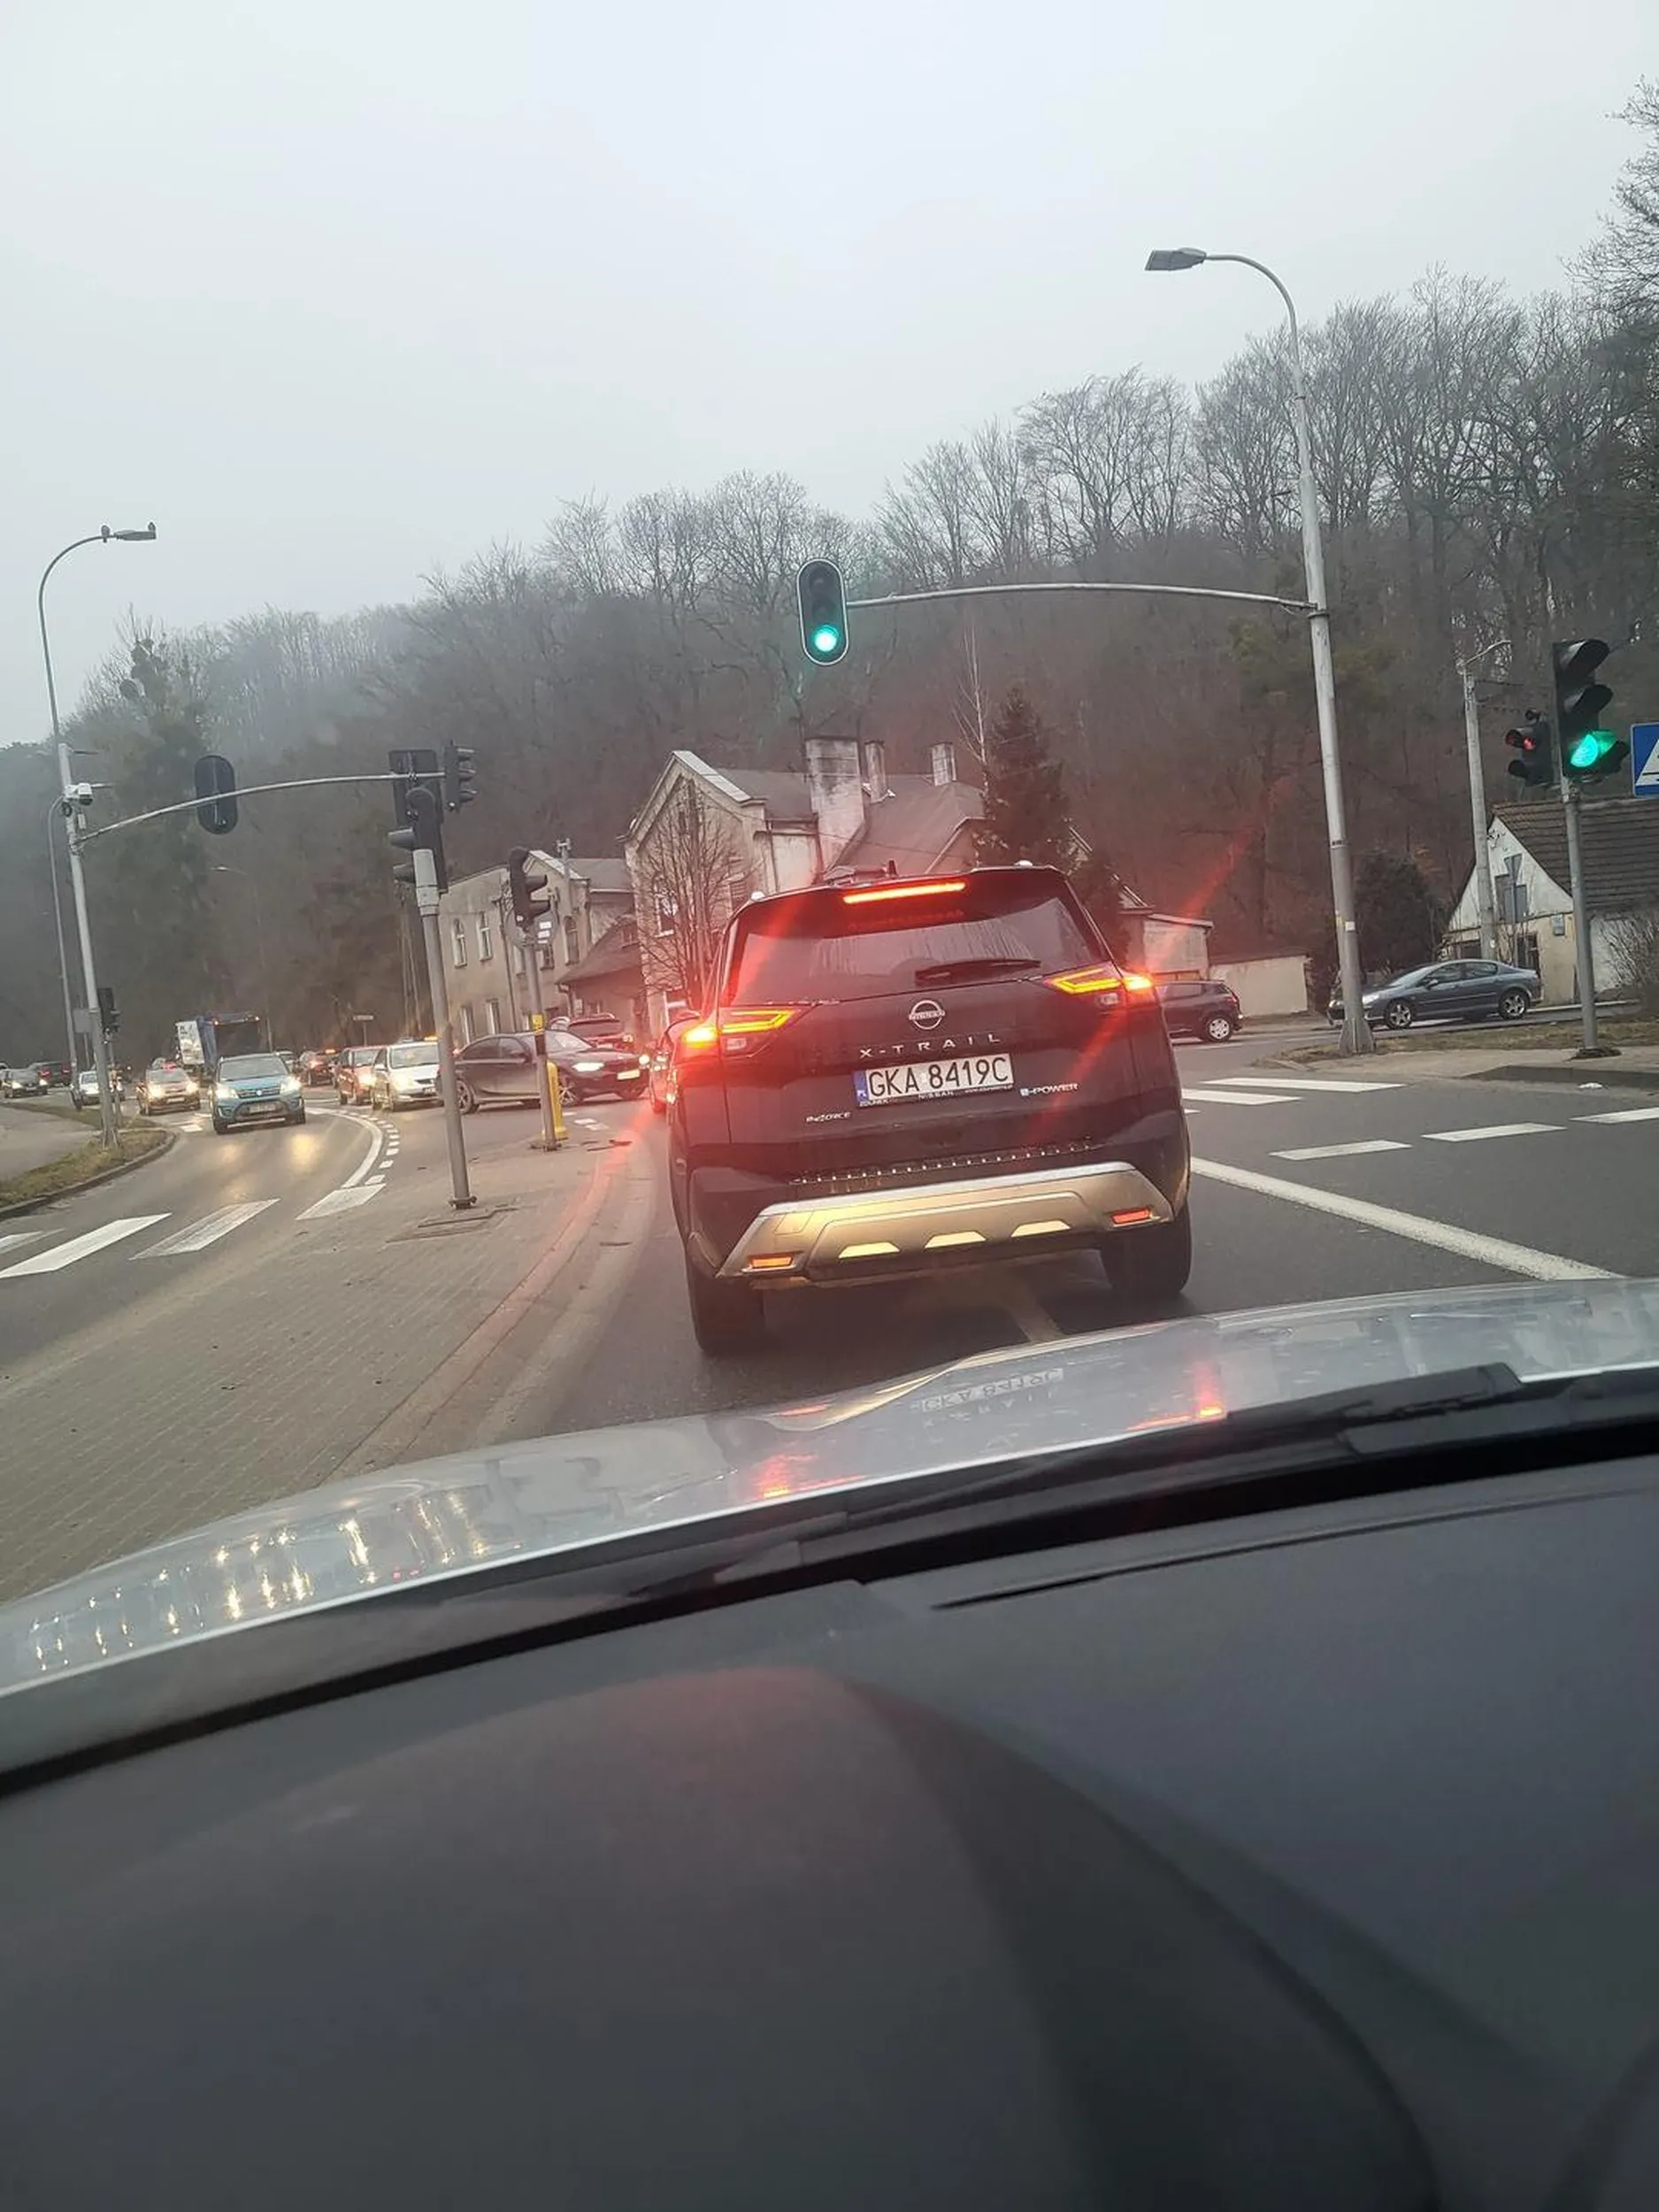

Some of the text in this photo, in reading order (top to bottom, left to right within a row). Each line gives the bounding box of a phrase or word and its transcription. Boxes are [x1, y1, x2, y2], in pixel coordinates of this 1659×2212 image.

[860, 1033, 1001, 1058] X-TRAIL
[869, 1057, 1009, 1097] GKA 8419C
